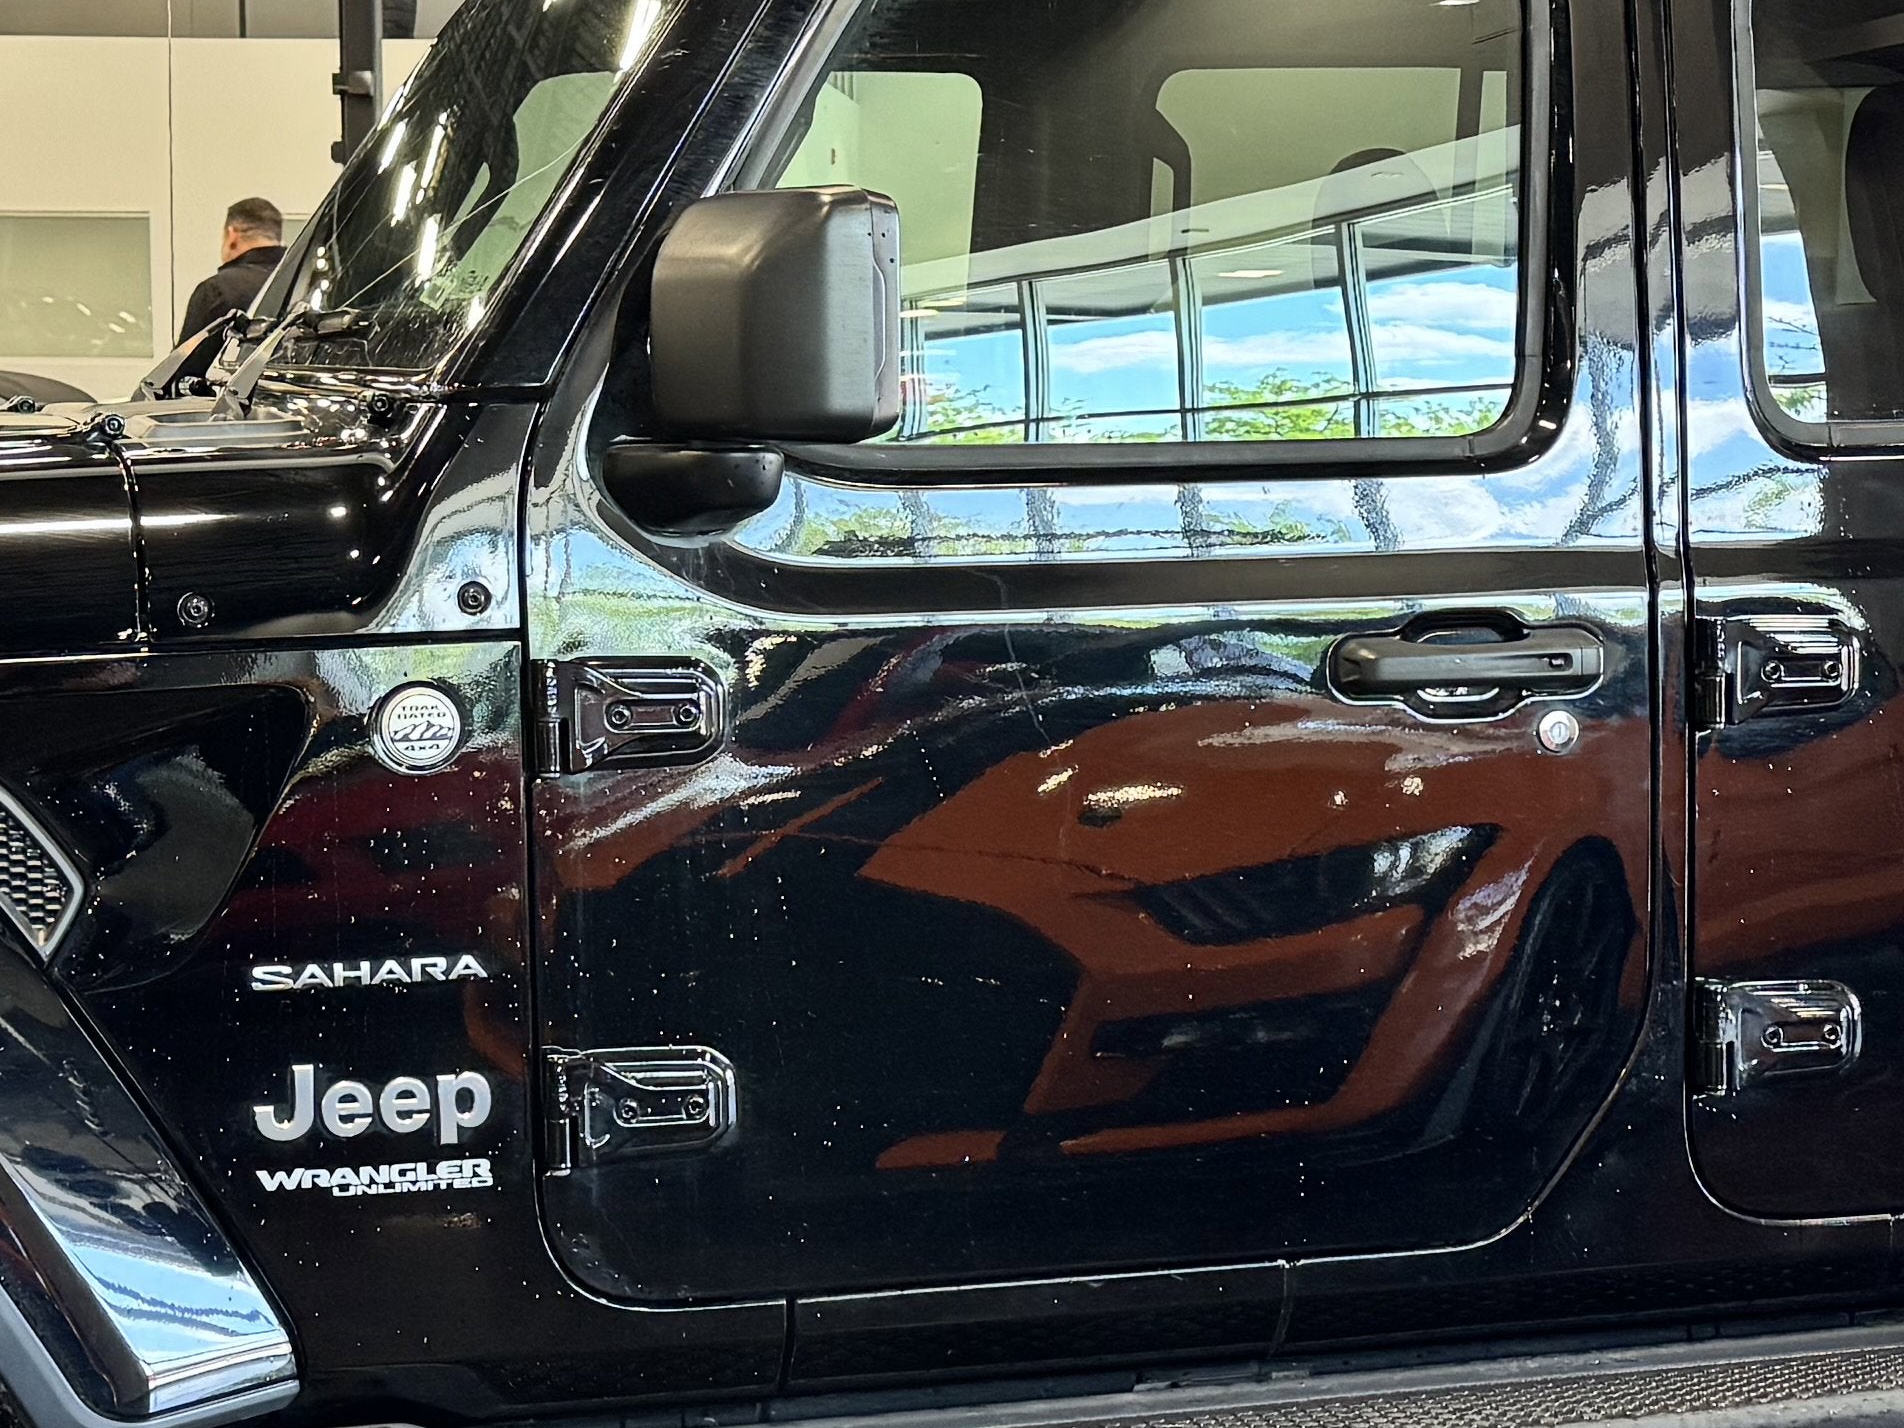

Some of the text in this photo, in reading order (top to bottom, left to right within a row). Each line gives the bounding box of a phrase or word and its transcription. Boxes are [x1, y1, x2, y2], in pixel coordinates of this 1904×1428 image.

[251, 954, 488, 991] SAHARA
[253, 1064, 492, 1145] Jeep
[256, 1158, 493, 1191] WRANGLER
[332, 1177, 494, 1197] UNLIMITED
